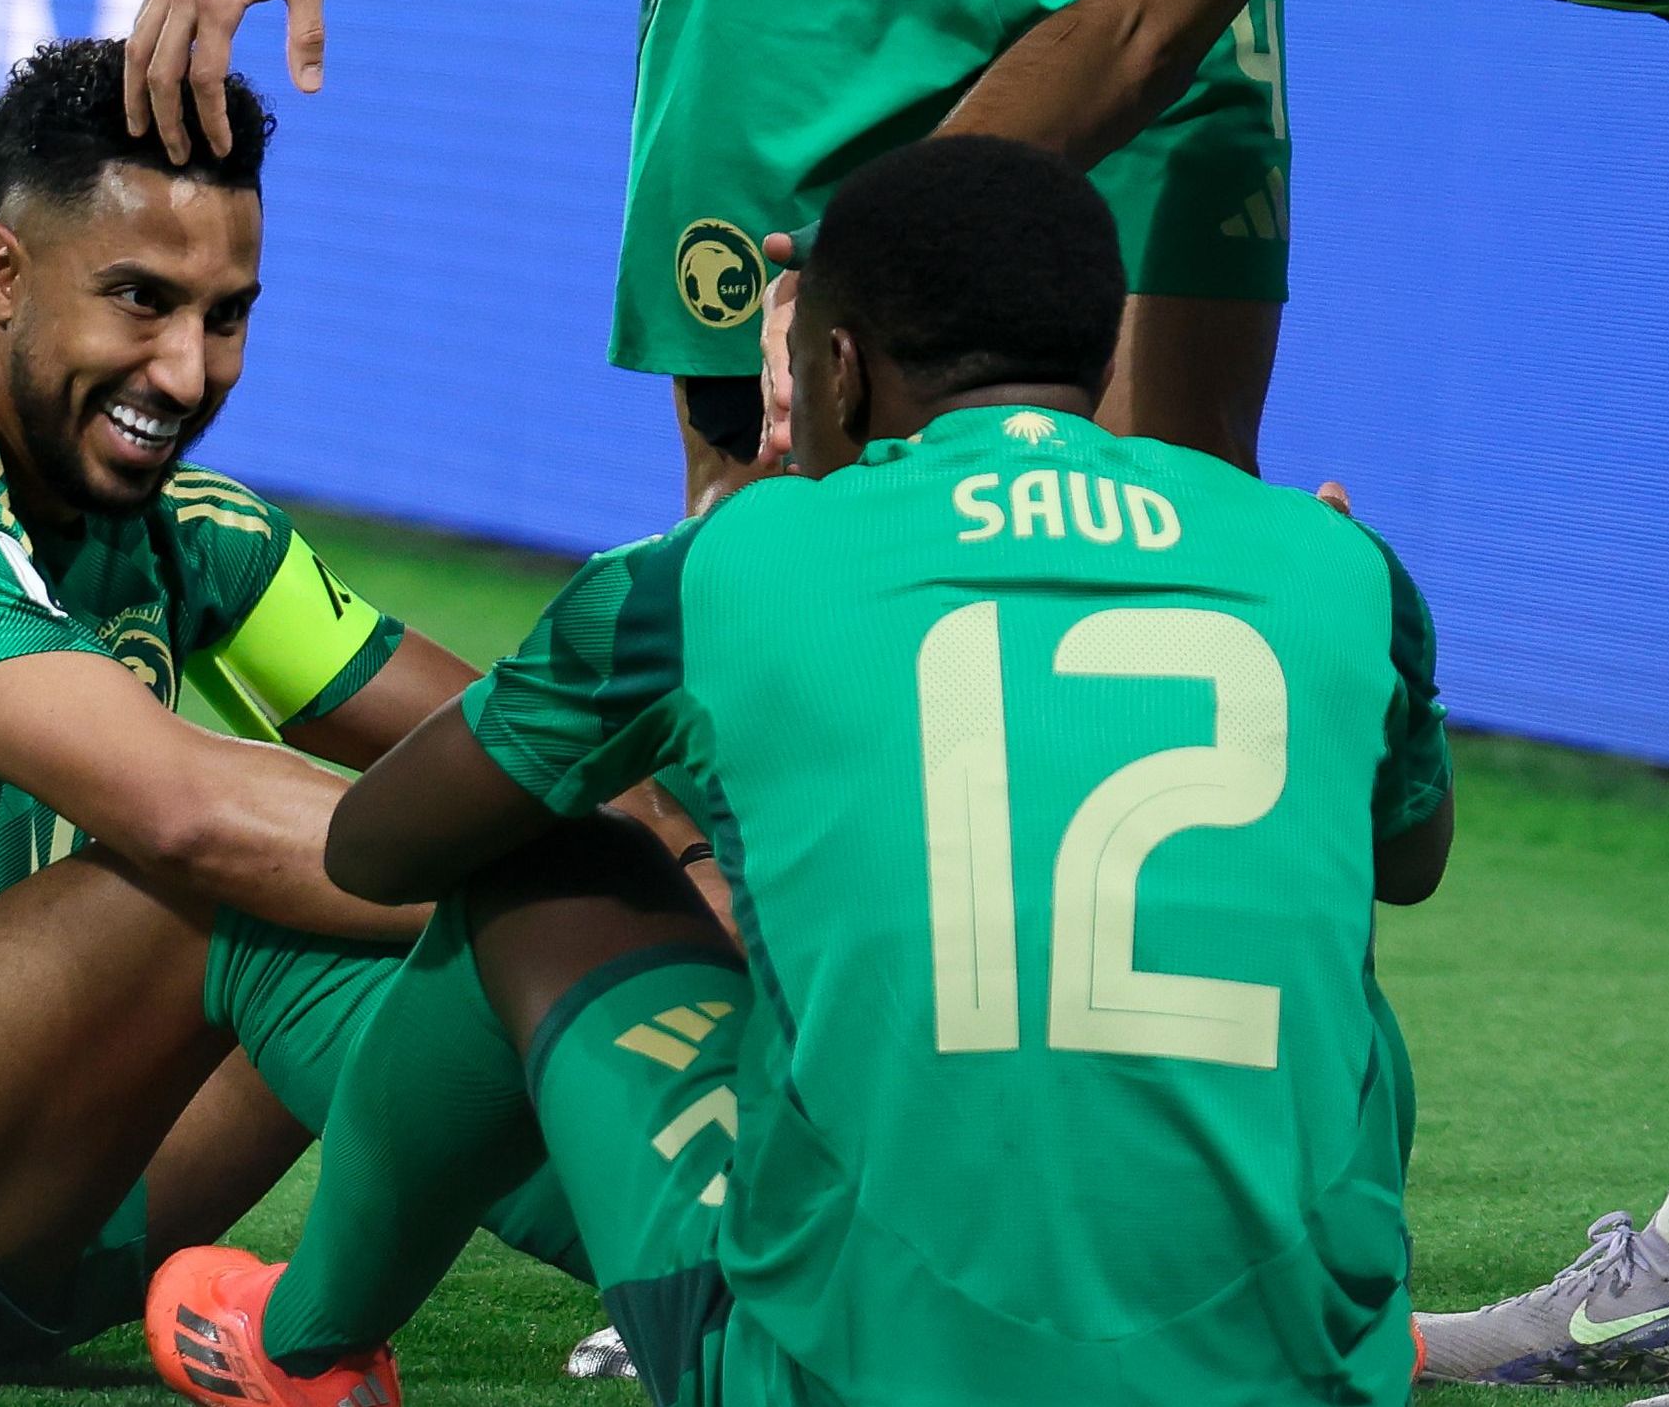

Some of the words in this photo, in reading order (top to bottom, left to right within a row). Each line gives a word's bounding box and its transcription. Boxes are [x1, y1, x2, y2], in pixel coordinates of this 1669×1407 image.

[719, 284, 748, 295] SAFF
[953, 468, 1182, 552] SAUD
[915, 599, 1288, 1070] 12
